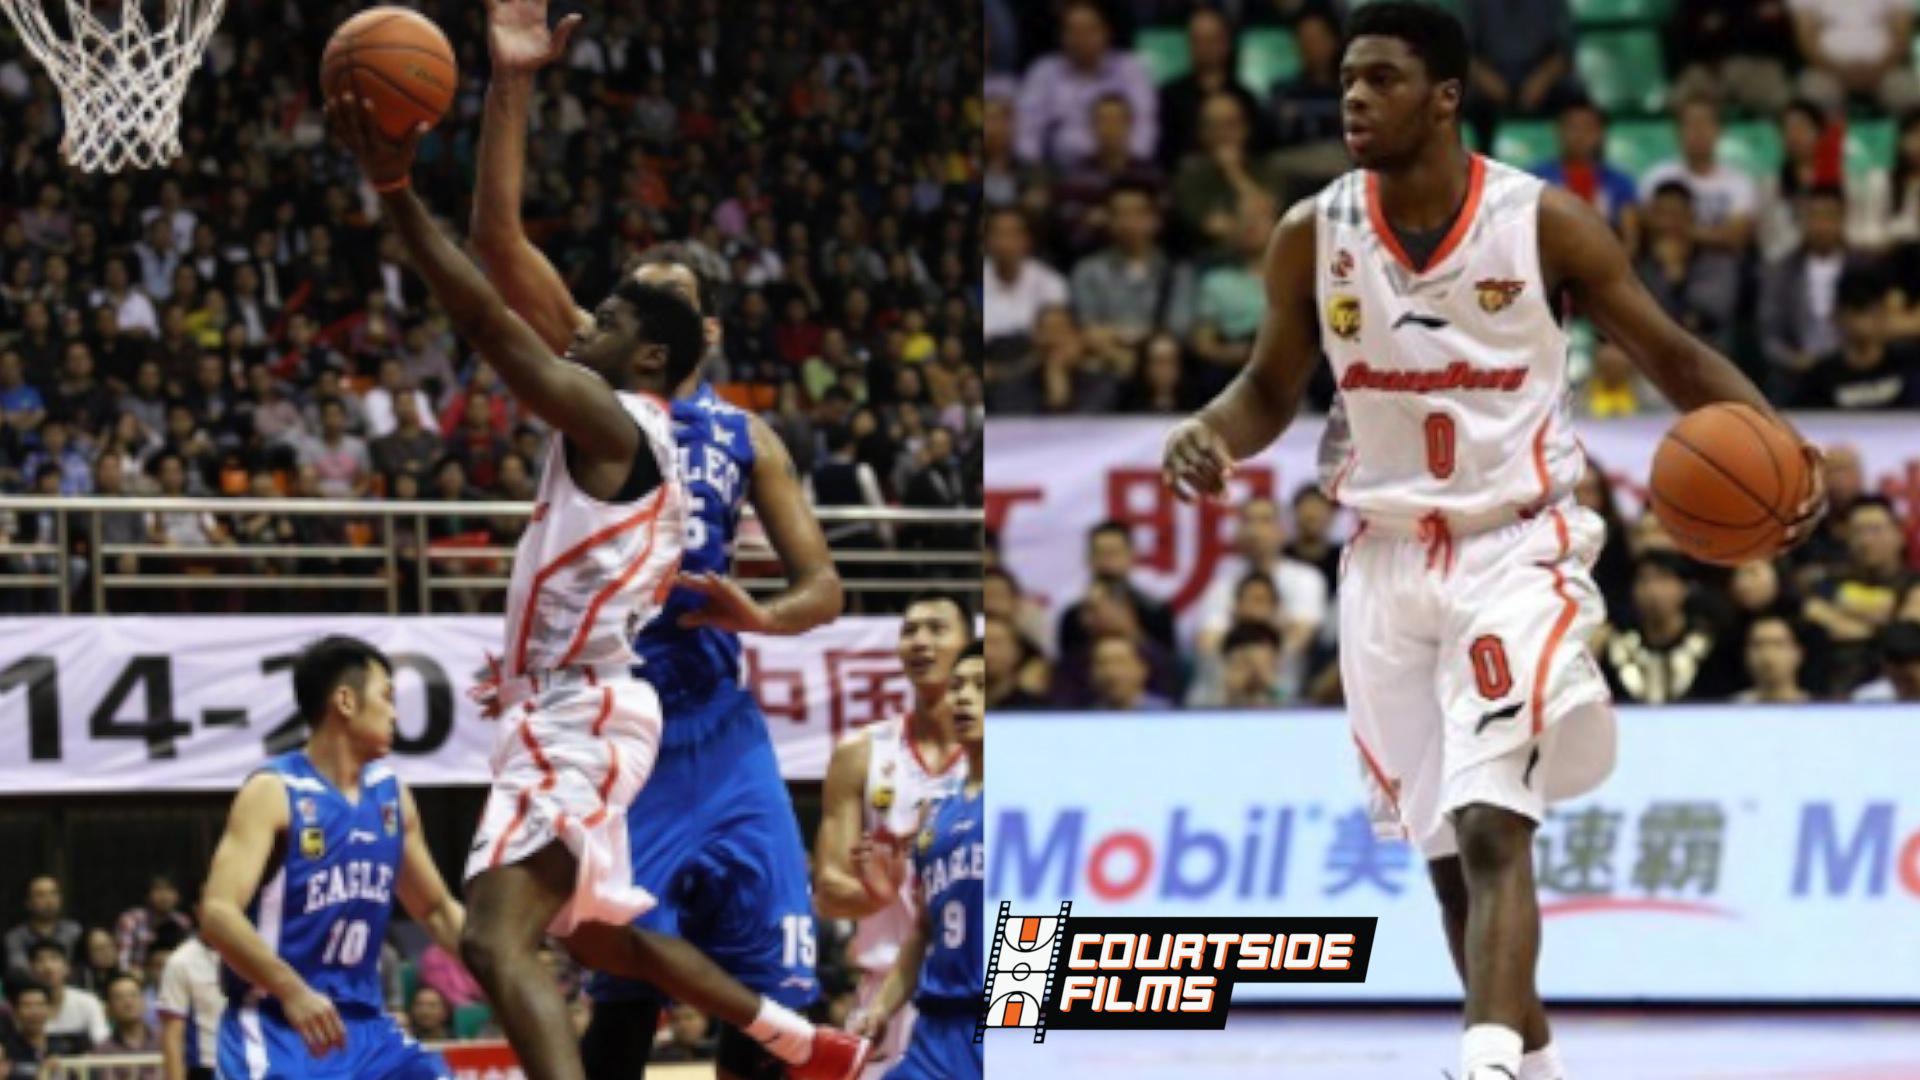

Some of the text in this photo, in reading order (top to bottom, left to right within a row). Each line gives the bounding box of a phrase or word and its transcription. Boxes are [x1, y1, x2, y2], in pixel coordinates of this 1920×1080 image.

[1424, 412, 1455, 479] 0
[1469, 634, 1512, 700] 0
[987, 808, 1294, 903] Mobil
[322, 918, 370, 965] 10
[781, 915, 816, 967] 15
[944, 900, 966, 949] 9
